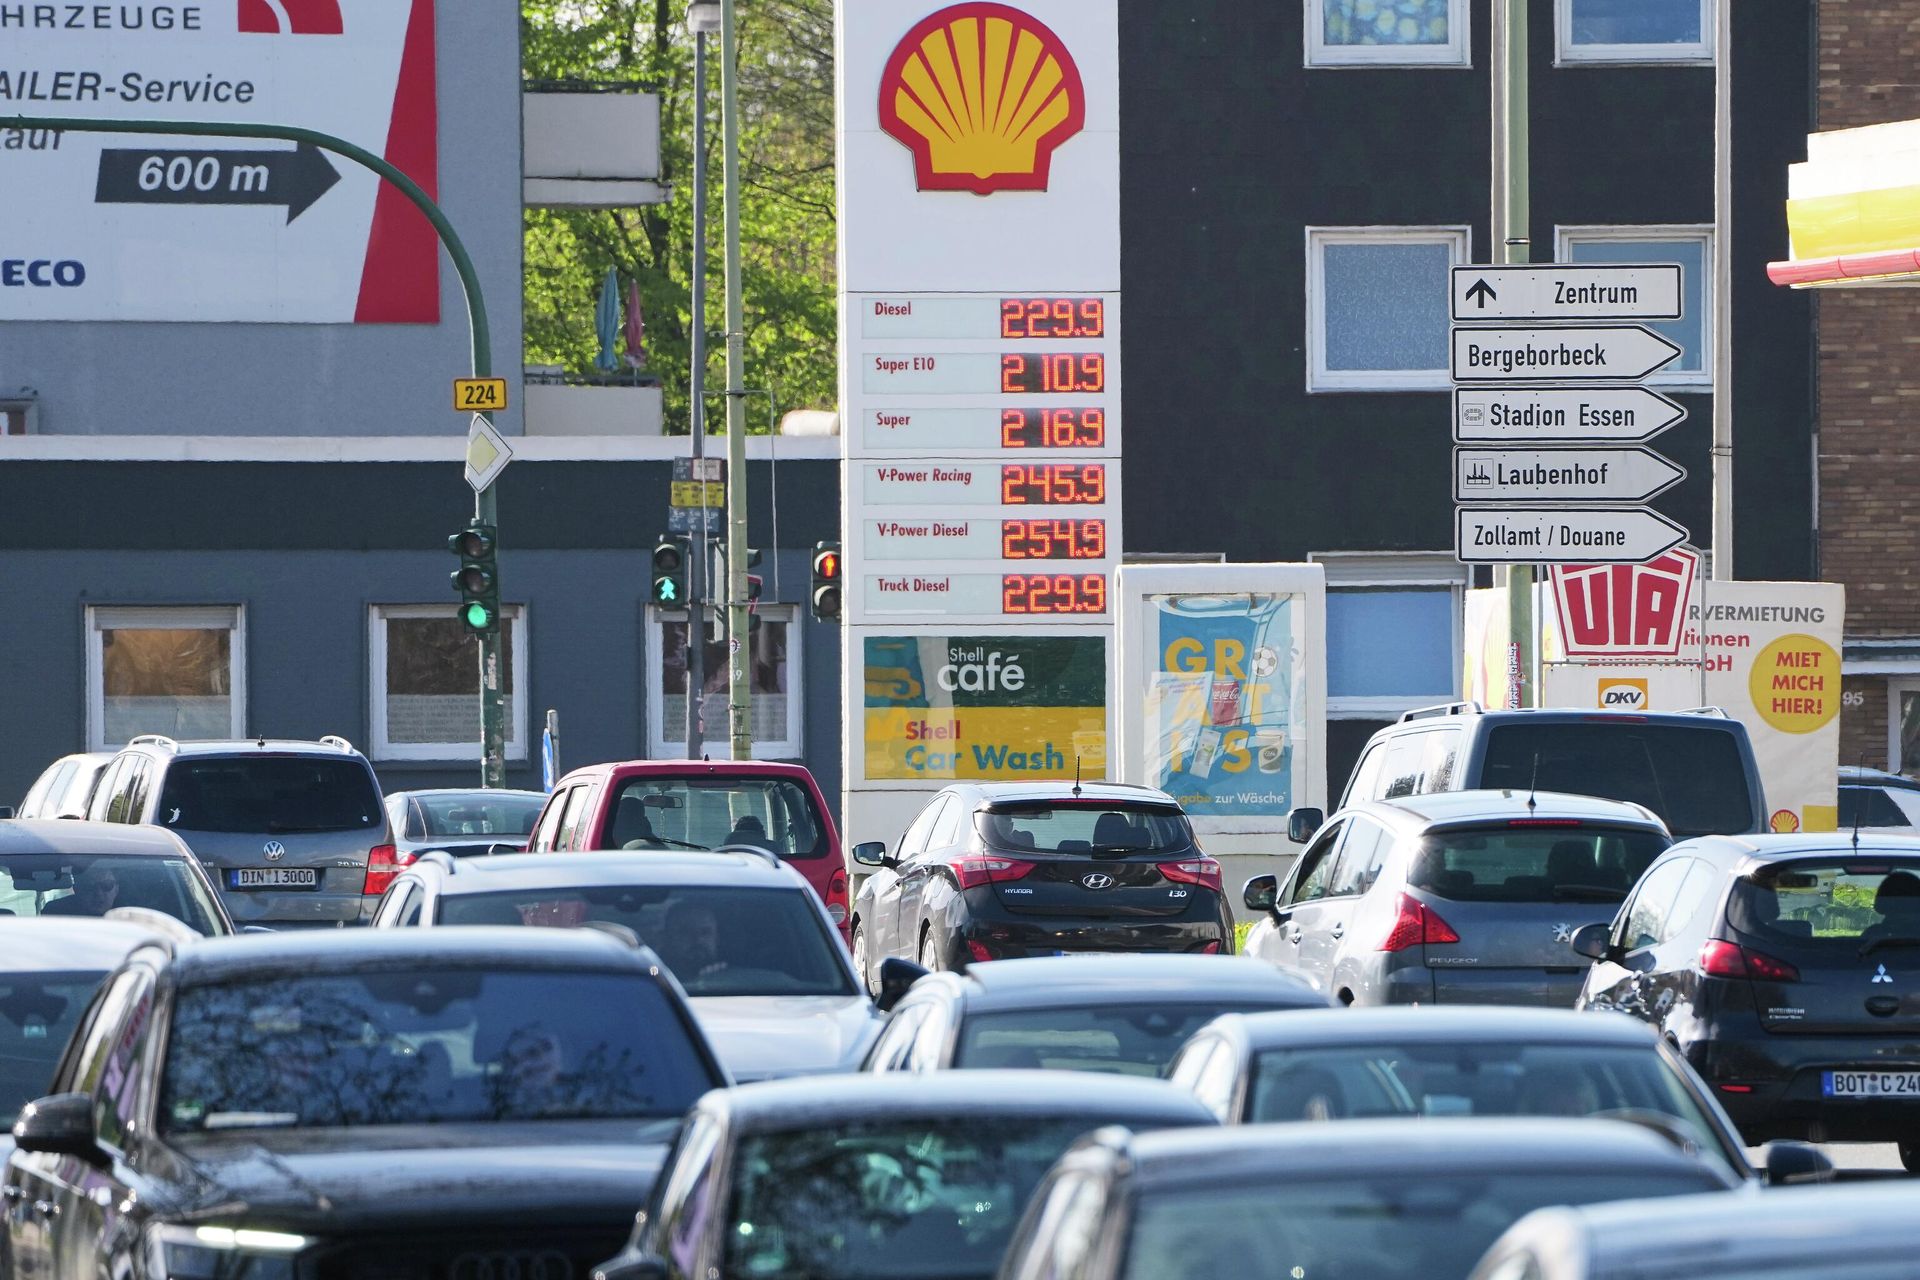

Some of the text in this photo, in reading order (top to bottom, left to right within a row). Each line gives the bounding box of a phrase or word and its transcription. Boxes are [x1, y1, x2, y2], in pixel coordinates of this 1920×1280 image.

[1, 5, 201, 30] HRZEUGE
[0, 71, 255, 103] AILER-Service
[138, 156, 270, 192] 600 m
[1, 260, 86, 287] ECO
[1555, 281, 1637, 304] Zentrum
[875, 300, 1103, 336] Diesel 229.9
[875, 358, 909, 373] Super
[914, 358, 935, 371] E10
[1469, 343, 1606, 372] Bergeborbeck
[465, 385, 496, 404] 224
[876, 413, 910, 428] Super
[1490, 404, 1635, 426] Stadion Essen
[878, 465, 1104, 501] V-Power Racing 245.9
[1497, 463, 1608, 485] Laubenhof
[878, 520, 1104, 556] V-Power Diesel 254.9
[1474, 525, 1625, 546] Zollamt / Douane
[878, 575, 1104, 611] Truck Diesel 229.9
[949, 647, 984, 662] Shell
[1776, 652, 1821, 667] MIET
[937, 652, 1025, 691] café
[1772, 675, 1824, 691] MICH
[1604, 692, 1642, 704] DKV
[1772, 698, 1822, 715] HIER!
[906, 720, 961, 740] Shell
[905, 745, 962, 771] Car
[972, 743, 1064, 770] Wash
[1215, 795, 1235, 803] zur
[241, 870, 264, 883] DIN
[1835, 1074, 1867, 1092] BOT
[1881, 1075, 1892, 1092] C
